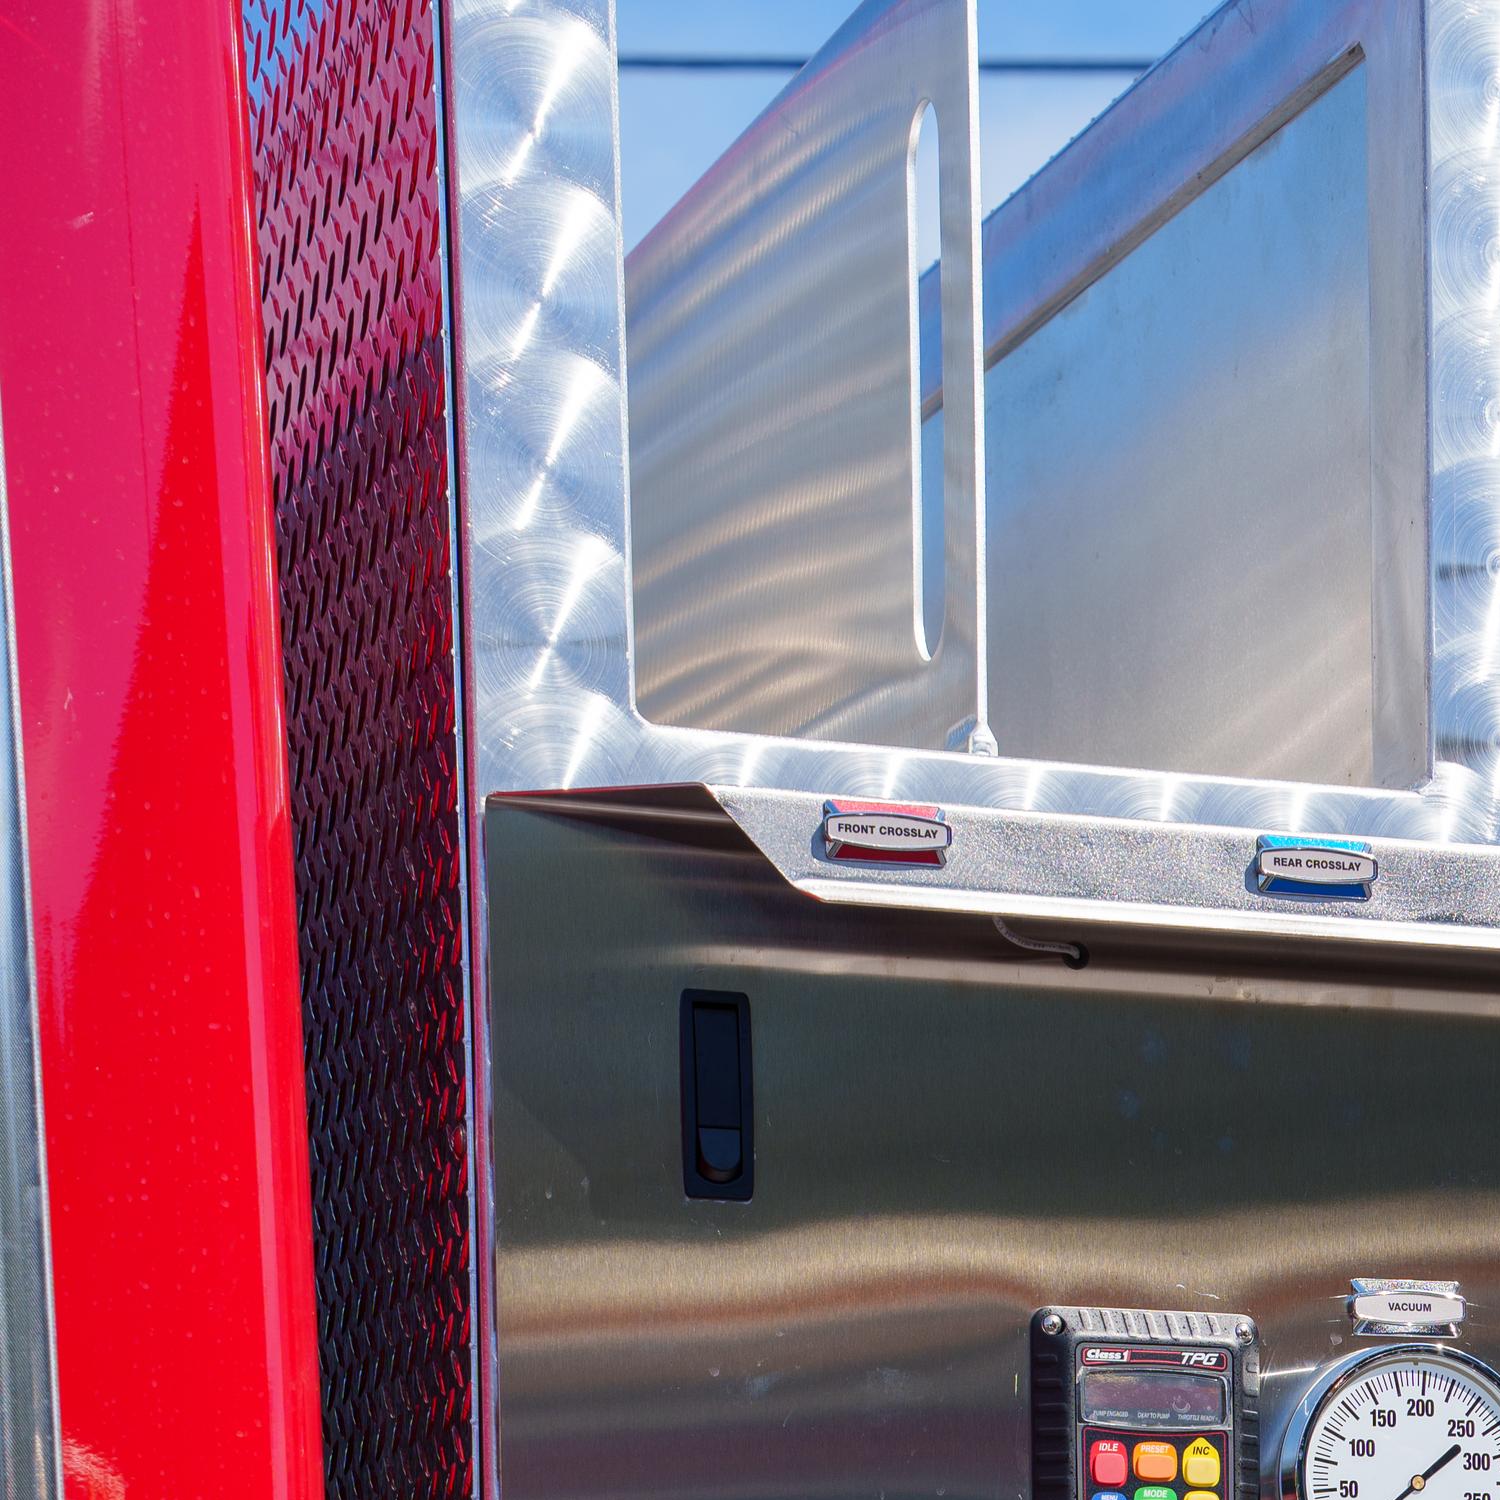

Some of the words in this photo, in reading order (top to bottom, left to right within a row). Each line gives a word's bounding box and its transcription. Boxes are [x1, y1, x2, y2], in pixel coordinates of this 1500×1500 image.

[838, 824, 875, 834] FRONT
[880, 827, 938, 839] CROSSLAY
[1274, 858, 1302, 867] REAR
[1306, 860, 1361, 871] CROSSLAY
[1388, 1302, 1431, 1312] VACUUM
[1087, 1349, 1128, 1362] Class1
[1181, 1353, 1219, 1365] TPG
[1407, 1399, 1435, 1417] 200
[1370, 1409, 1396, 1427] 150
[1448, 1420, 1475, 1437] 250
[1099, 1444, 1118, 1452] IDLE
[1141, 1445, 1170, 1453] PRESET
[1193, 1447, 1210, 1455] INC
[1349, 1439, 1375, 1457] 100
[1463, 1453, 1490, 1471] 300
[1144, 1490, 1168, 1498] MODE
[1339, 1480, 1358, 1498] 50
